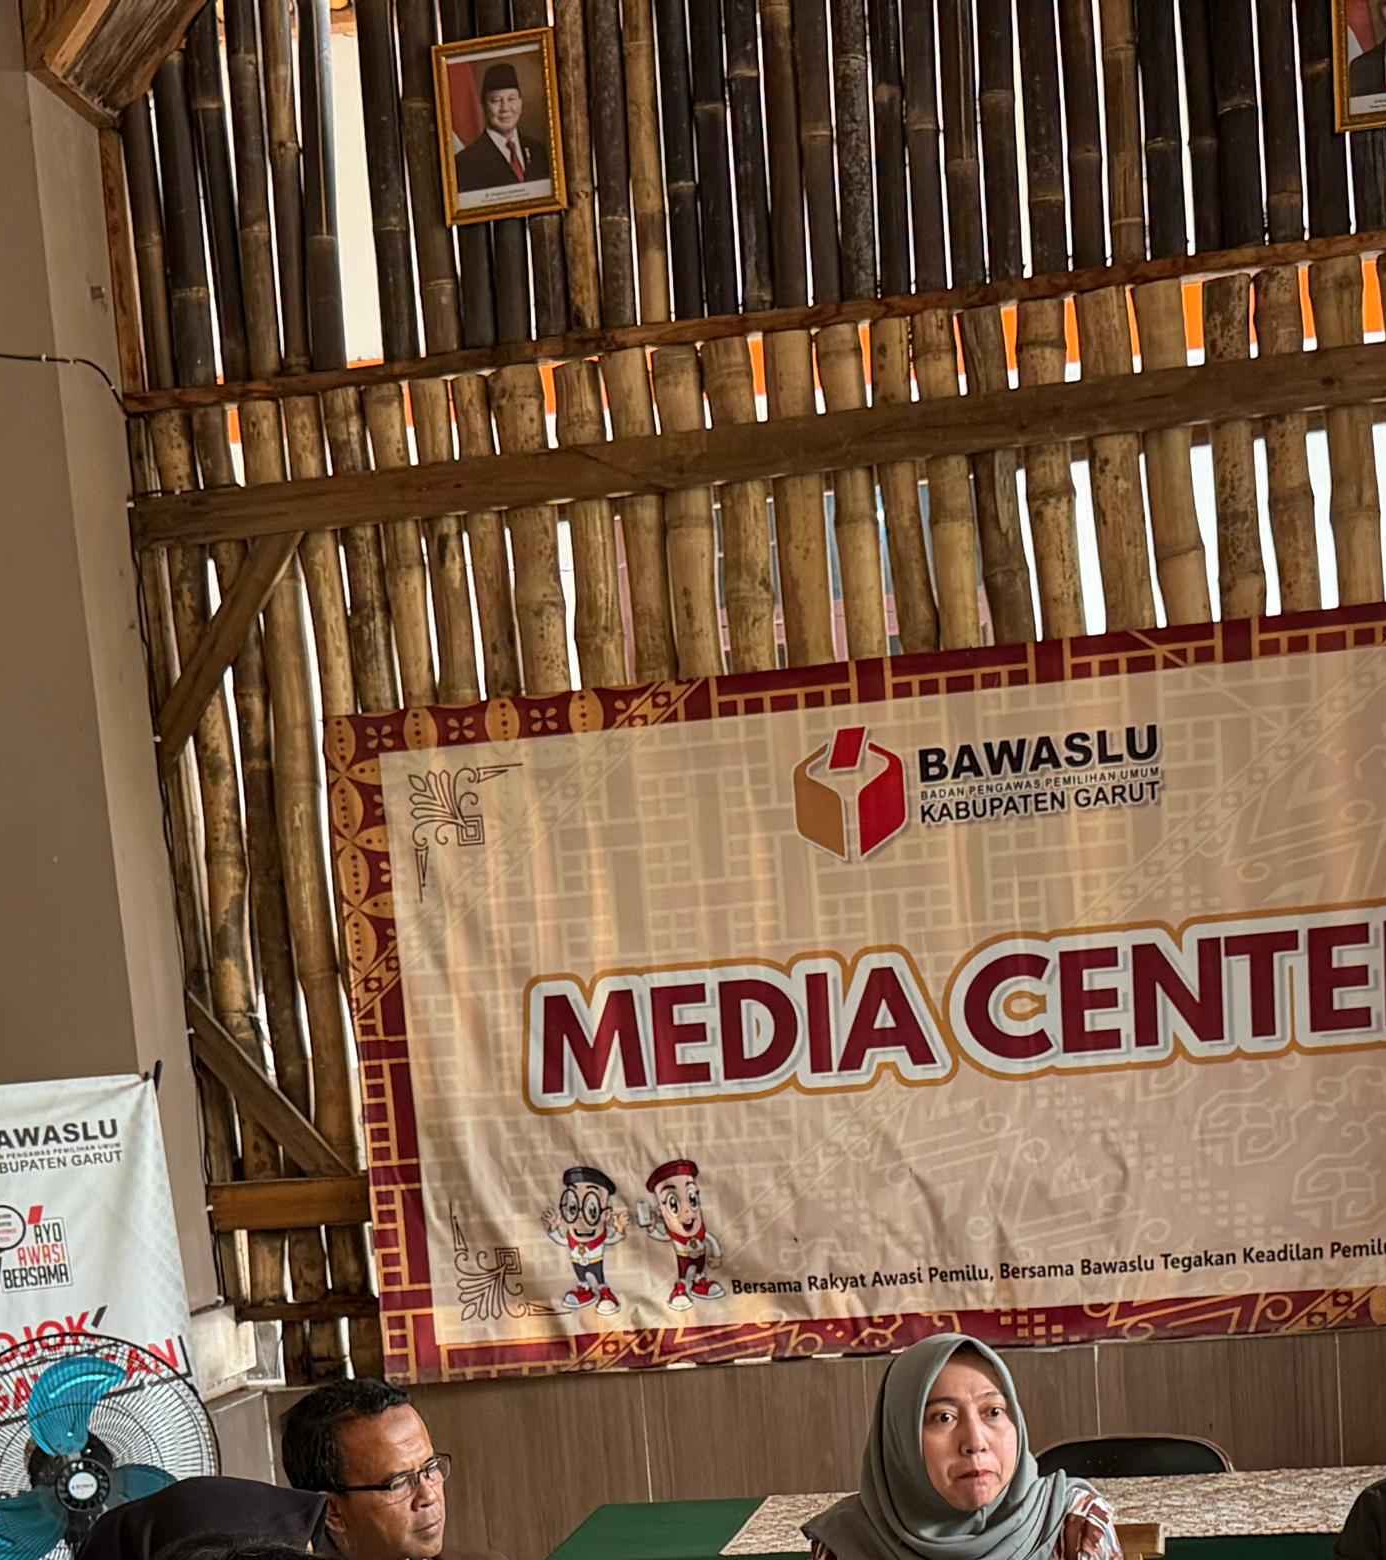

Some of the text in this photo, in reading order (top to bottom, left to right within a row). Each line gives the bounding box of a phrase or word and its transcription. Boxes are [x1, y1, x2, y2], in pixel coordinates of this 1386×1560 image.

[918, 724, 1159, 783] BAWASLU
[921, 767, 1160, 800] BADAN PENGAWAS PEMILIHAN UMUM
[920, 780, 1161, 824] KABUPATEN GARUT
[540, 967, 938, 1095] MEDIA
[70, 1150, 123, 1168] GARUT
[34, 1222, 63, 1244] AYO
[17, 1243, 66, 1266] AWASI
[731, 1278, 803, 1296] Bersama
[807, 1273, 867, 1293] Rakyat
[871, 1266, 924, 1287] Awasi
[928, 1265, 995, 1285] Pemilu,
[999, 1260, 1075, 1280] Bersama
[1080, 1254, 1155, 1276] Bawaslu
[1160, 1250, 1237, 1273] Tegakan
[1241, 1243, 1324, 1264] Keadilan
[3, 1263, 70, 1289] BERSAMA
